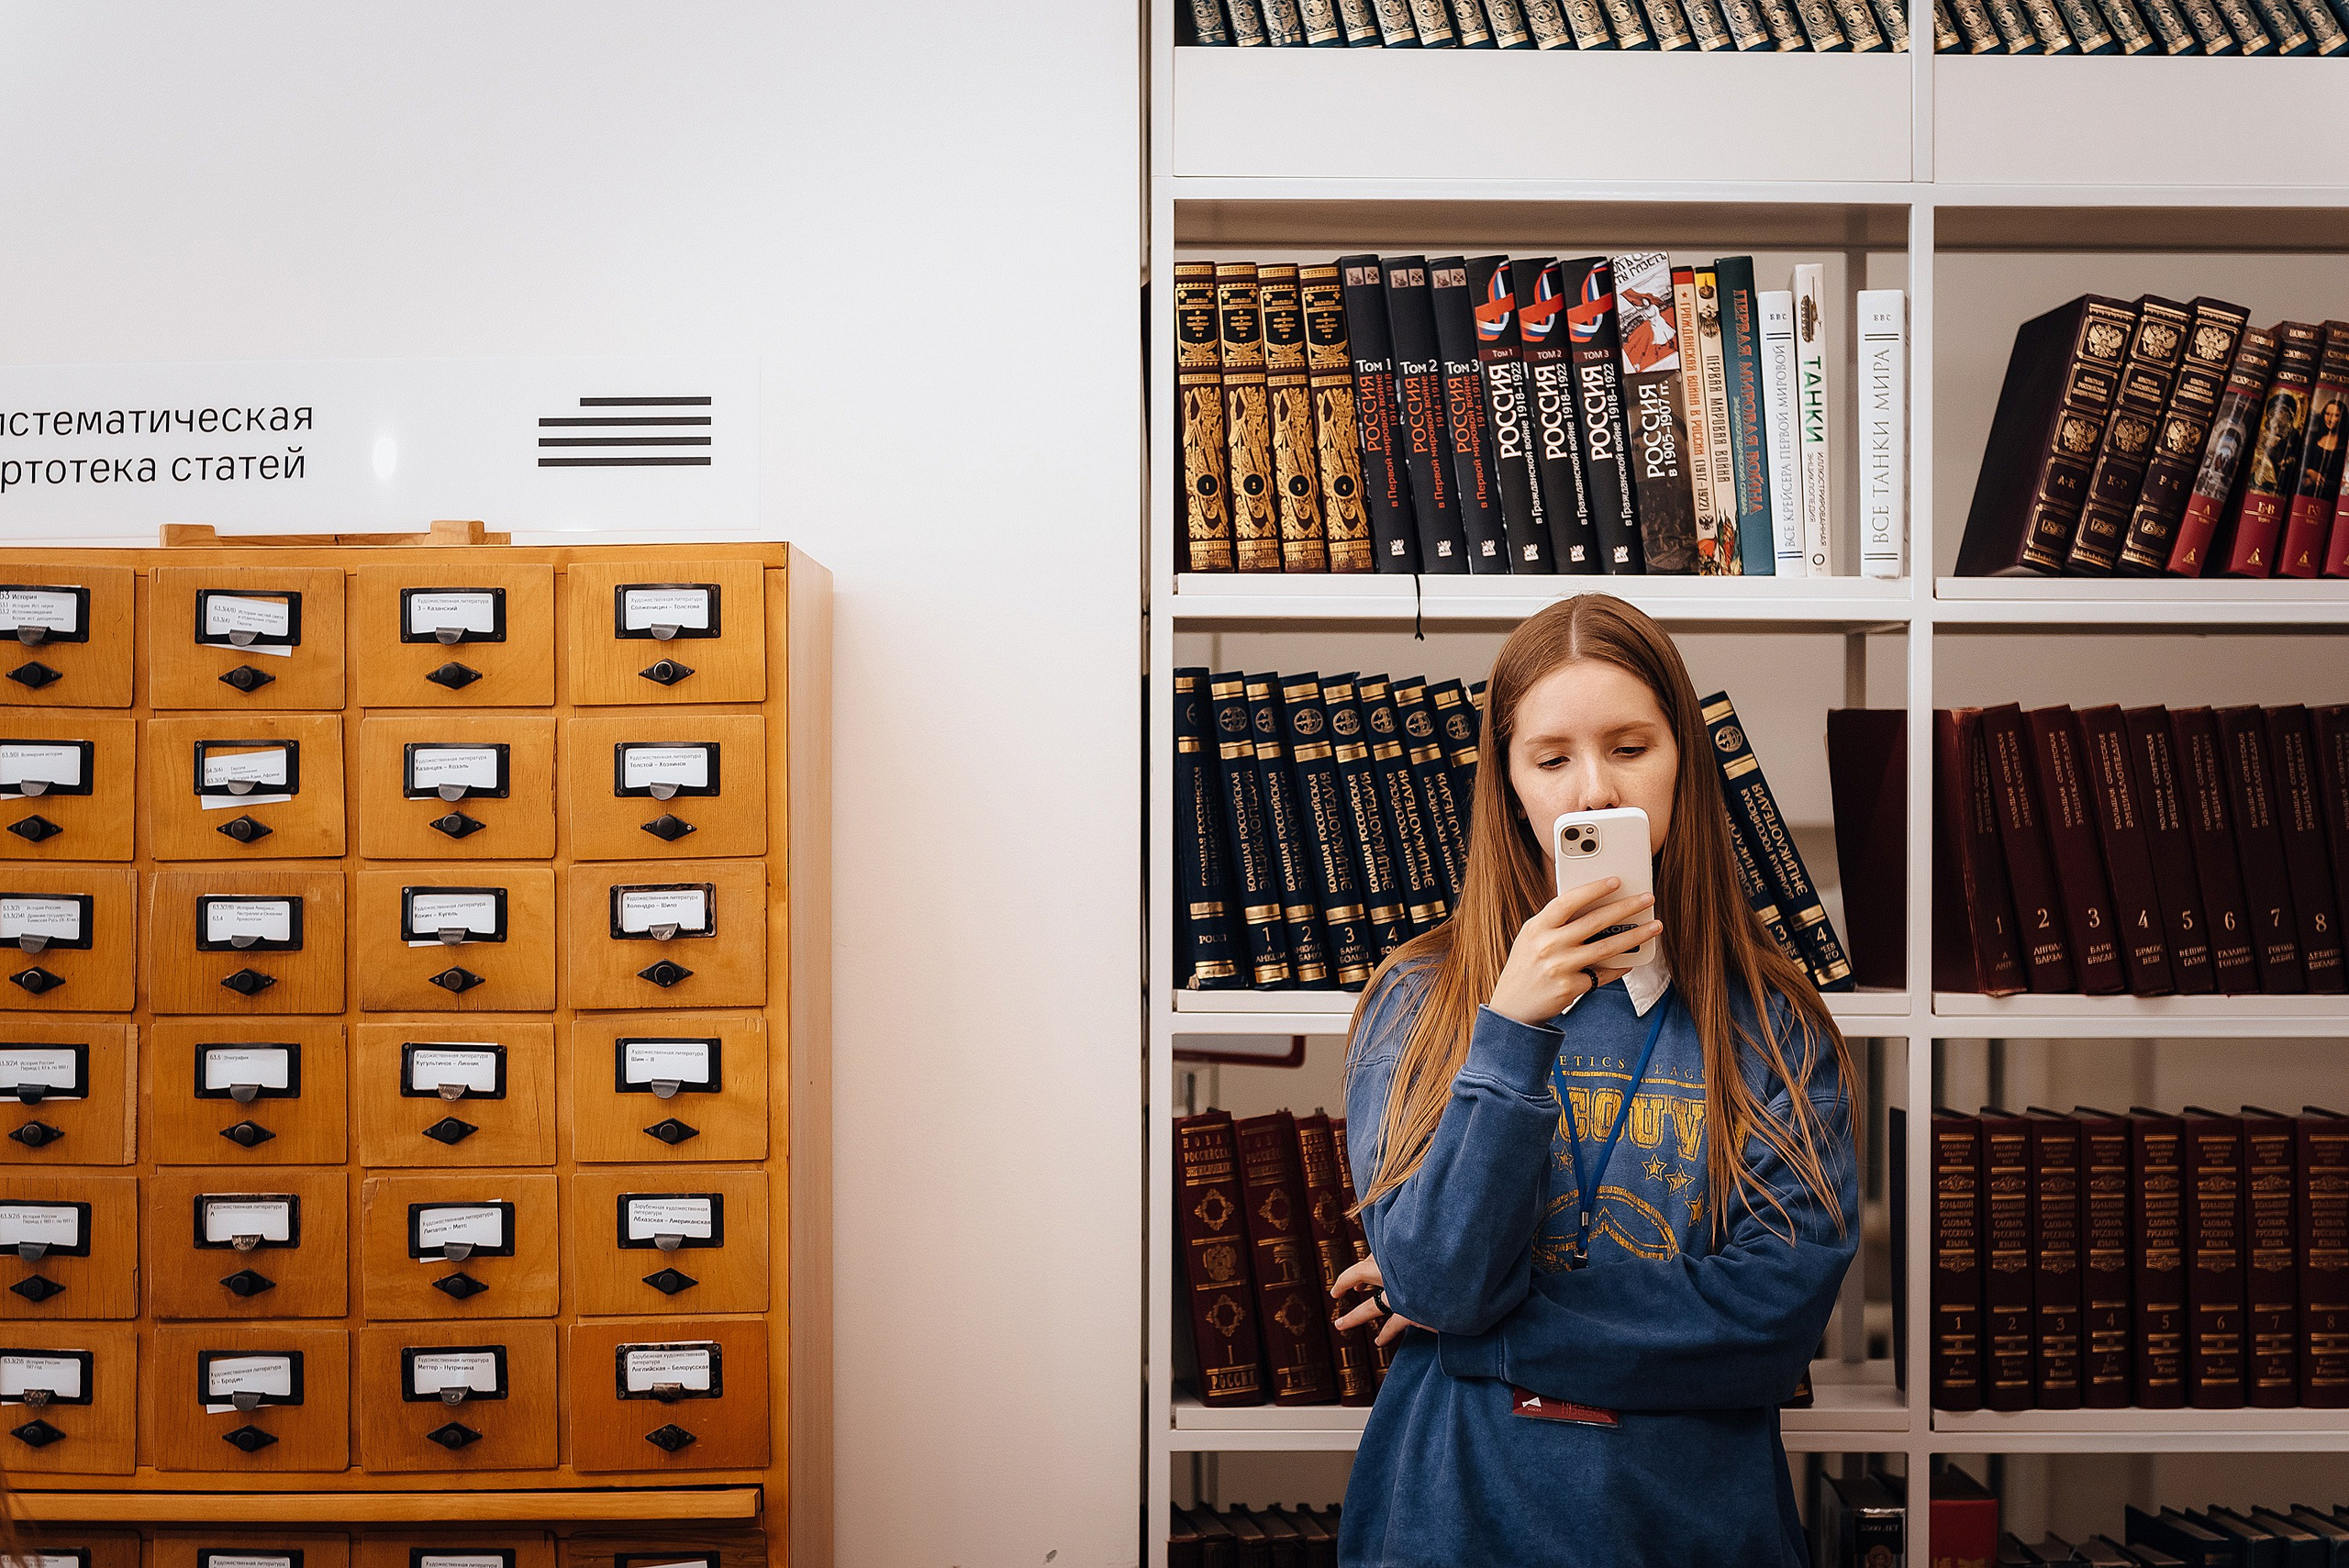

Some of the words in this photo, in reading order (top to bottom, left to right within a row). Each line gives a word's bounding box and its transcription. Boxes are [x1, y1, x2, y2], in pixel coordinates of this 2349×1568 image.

[1680, 303, 1696, 372] ГРАЖДАНСКАЯ
[1732, 289, 1753, 357] ПЕРВАЯ
[1386, 358, 1392, 371] 1
[1429, 359, 1439, 372] 2
[1470, 359, 1480, 373] 3
[1556, 350, 1563, 358] 2
[1707, 356, 1721, 393] ПЕРВАЯ
[1775, 344, 1788, 407] МИРОВОЙ
[1375, 374, 1386, 407] войне
[1385, 373, 1398, 426] 1914-1918
[1421, 375, 1431, 408] войне
[1431, 374, 1444, 428] 1914-1918
[1463, 375, 1474, 408] войне
[1471, 374, 1486, 428] 1914-1918
[1510, 361, 1528, 417] 1918-1922
[1555, 362, 1574, 419] 1918-1922
[1603, 362, 1620, 419] 1918-1922
[1687, 375, 1700, 406] ВОЙНА
[1803, 356, 1823, 442] ТАНКИ
[1873, 349, 1890, 411] МИРА
[1359, 375, 1383, 451] РОССИЯ
[1405, 377, 1429, 453] РОССИЯ
[1448, 377, 1472, 453] РОССИЯ
[1488, 363, 1522, 459] РОССИЯ
[1534, 365, 1568, 460] РОССИЯ
[1580, 365, 1613, 461] РОССИЯ
[1710, 397, 1727, 445] МИРОВАЯ
[1739, 361, 1760, 447] МИРОВАЯ
[1378, 409, 1392, 456] мировой
[1425, 410, 1439, 457] мировой
[1467, 411, 1481, 457] мировой
[1520, 420, 1533, 450] войне
[1565, 421, 1579, 450] войне
[1610, 421, 1623, 451] войне
[1638, 384, 1666, 479] РОССИЯ
[1691, 420, 1705, 455] РОССИИ
[1778, 412, 1791, 461] ПЕРВОЙ
[0, 457, 156, 493] ртотека
[171, 446, 305, 482] статей
[1385, 458, 1398, 499] Первой
[1431, 460, 1445, 500] Первой
[1473, 460, 1487, 500] Первой
[1668, 468, 1677, 477] в
[1715, 450, 1730, 483] ВОЙНА
[1745, 451, 1764, 516] ВОЙНА
[1873, 422, 1890, 498] ТАНКИ
[1524, 451, 1543, 517] Гражданской
[1570, 453, 1588, 517] Гражданской
[1615, 453, 1633, 519] Гражданской
[1695, 460, 1709, 511] (1917-1922)
[1781, 464, 1794, 521] КРЕЙСЕРА
[1785, 525, 1795, 548] ВСЕ
[1872, 506, 1889, 544] ВСЕ
[1230, 772, 1249, 840] РОССИЙСКАЯ
[1308, 773, 1328, 841] РОССИЙСКАЯ
[1347, 774, 1370, 842] РОССИЙСКАЯ
[1386, 773, 1409, 840] РОССИЙСКАЯ
[1397, 769, 1435, 889] ЭНЦИКЛОПЕДИЯ
[1740, 787, 1774, 852] РОССИЙСКАЯ
[1242, 770, 1271, 890] ЭНЦИКЛОПЕДИЯ
[1319, 771, 1353, 891] ЭНЦИКЛОПЕДИЯ
[1359, 772, 1395, 891] ЭНЦИКЛОПЕДИЯ
[1751, 783, 1809, 896] ЭНЦИКЛОПЕДИЯ
[1241, 842, 1257, 892] БОЛЬШАЯ
[1321, 844, 1338, 894] БОЛЬШАЯ
[1363, 844, 1380, 894] БОЛЬШАЯ
[1402, 842, 1421, 892] БОЛЬШАЯ
[1769, 853, 1795, 900] БОЛЬШАЯ
[1262, 927, 1270, 942] 1
[1301, 926, 1313, 942] 2
[1344, 928, 1355, 943] 3
[1387, 927, 1398, 942] 4
[1996, 916, 2002, 935] 1
[2037, 907, 2050, 929] 2
[2087, 907, 2100, 929] 3
[2138, 908, 2149, 929] 4
[2182, 909, 2193, 930] 5
[2224, 910, 2236, 931] 6
[2270, 907, 2282, 929] 7
[2315, 912, 2328, 933] 8
[1551, 1085, 1707, 1162] COUV
[1940, 1229, 1974, 1239] РУССКОГО
[1955, 1317, 1961, 1329] 1
[2009, 1317, 2017, 1330] 2
[2056, 1317, 2065, 1330] 3
[2162, 1316, 2170, 1329] 5
[2217, 1316, 2225, 1330] 6
